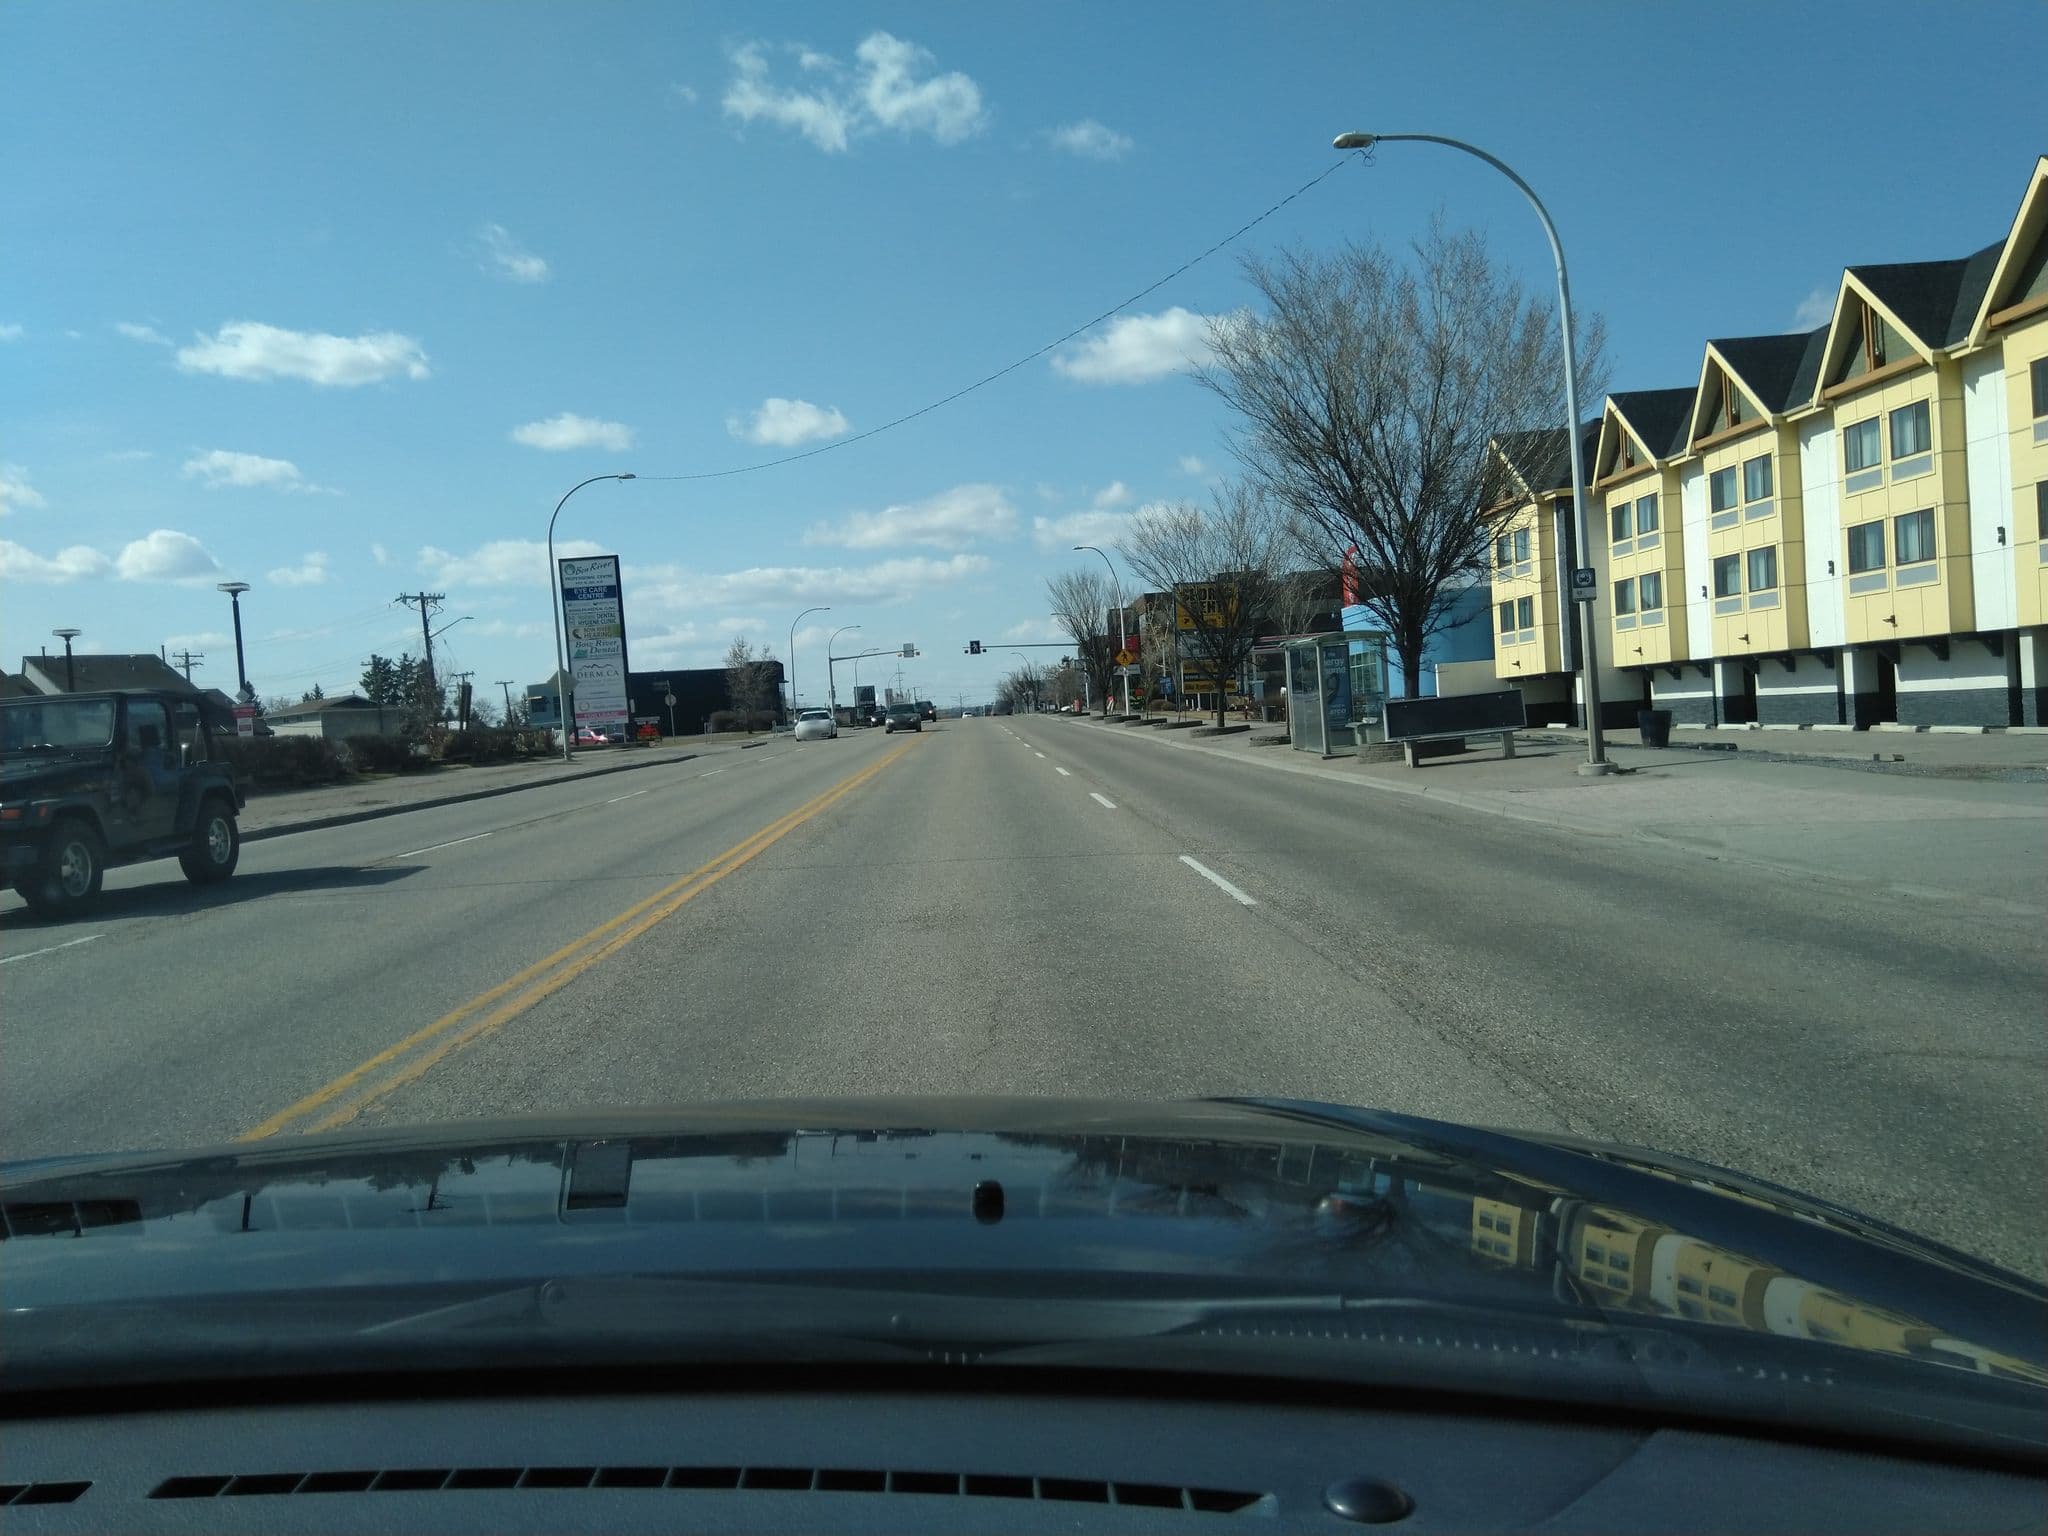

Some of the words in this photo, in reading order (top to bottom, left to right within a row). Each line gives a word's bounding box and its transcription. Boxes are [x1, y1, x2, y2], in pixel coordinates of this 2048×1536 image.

[590, 560, 612, 571] River
[577, 592, 605, 600] CENTRE
[583, 631, 611, 639] HEARING
[595, 639, 617, 647] River
[589, 645, 620, 654] Dental
